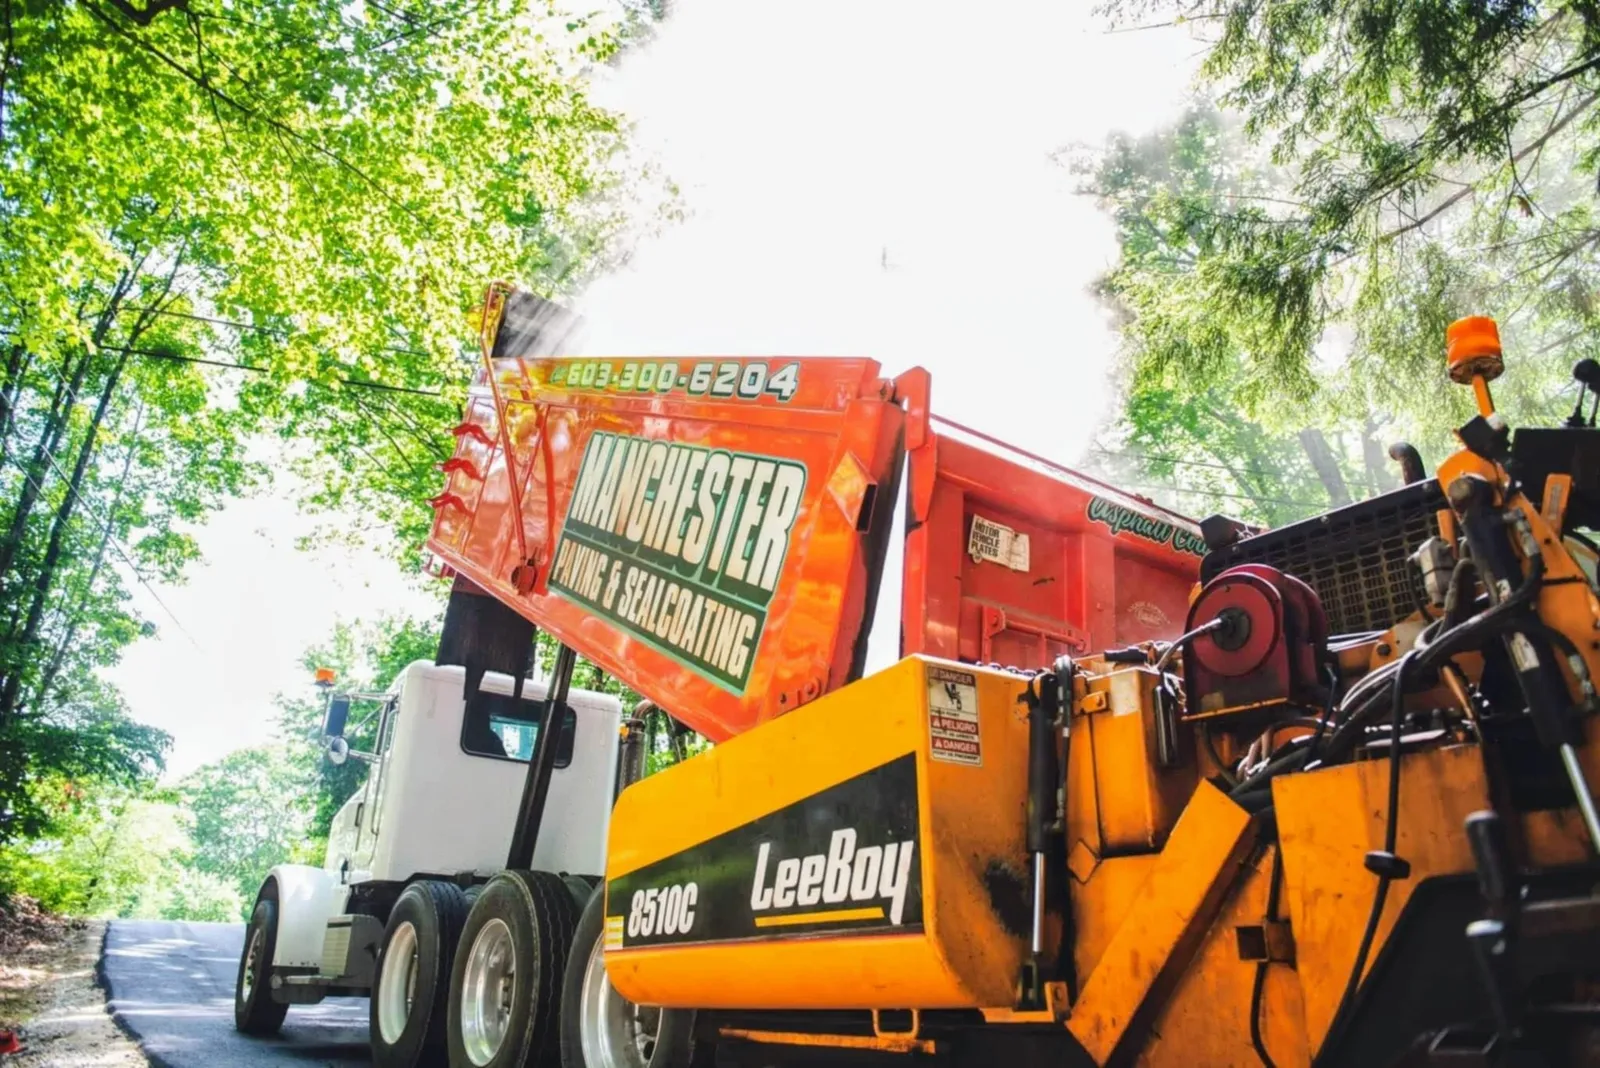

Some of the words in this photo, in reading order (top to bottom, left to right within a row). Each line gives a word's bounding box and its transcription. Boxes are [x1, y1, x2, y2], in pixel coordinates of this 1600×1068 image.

[570, 432, 805, 593] MANCHESTER
[975, 520, 1000, 538] MOTOR
[971, 540, 999, 557] PLATES
[972, 530, 1000, 549] VEHICLE
[552, 538, 609, 604] PAVING
[602, 558, 622, 610] &
[616, 565, 758, 680] SEALCOATING
[939, 670, 973, 684] DANGER
[941, 719, 977, 733] PELIGRO
[943, 740, 978, 754] DANGER
[751, 827, 914, 925] LeeBoy
[627, 881, 698, 938] 8510C
